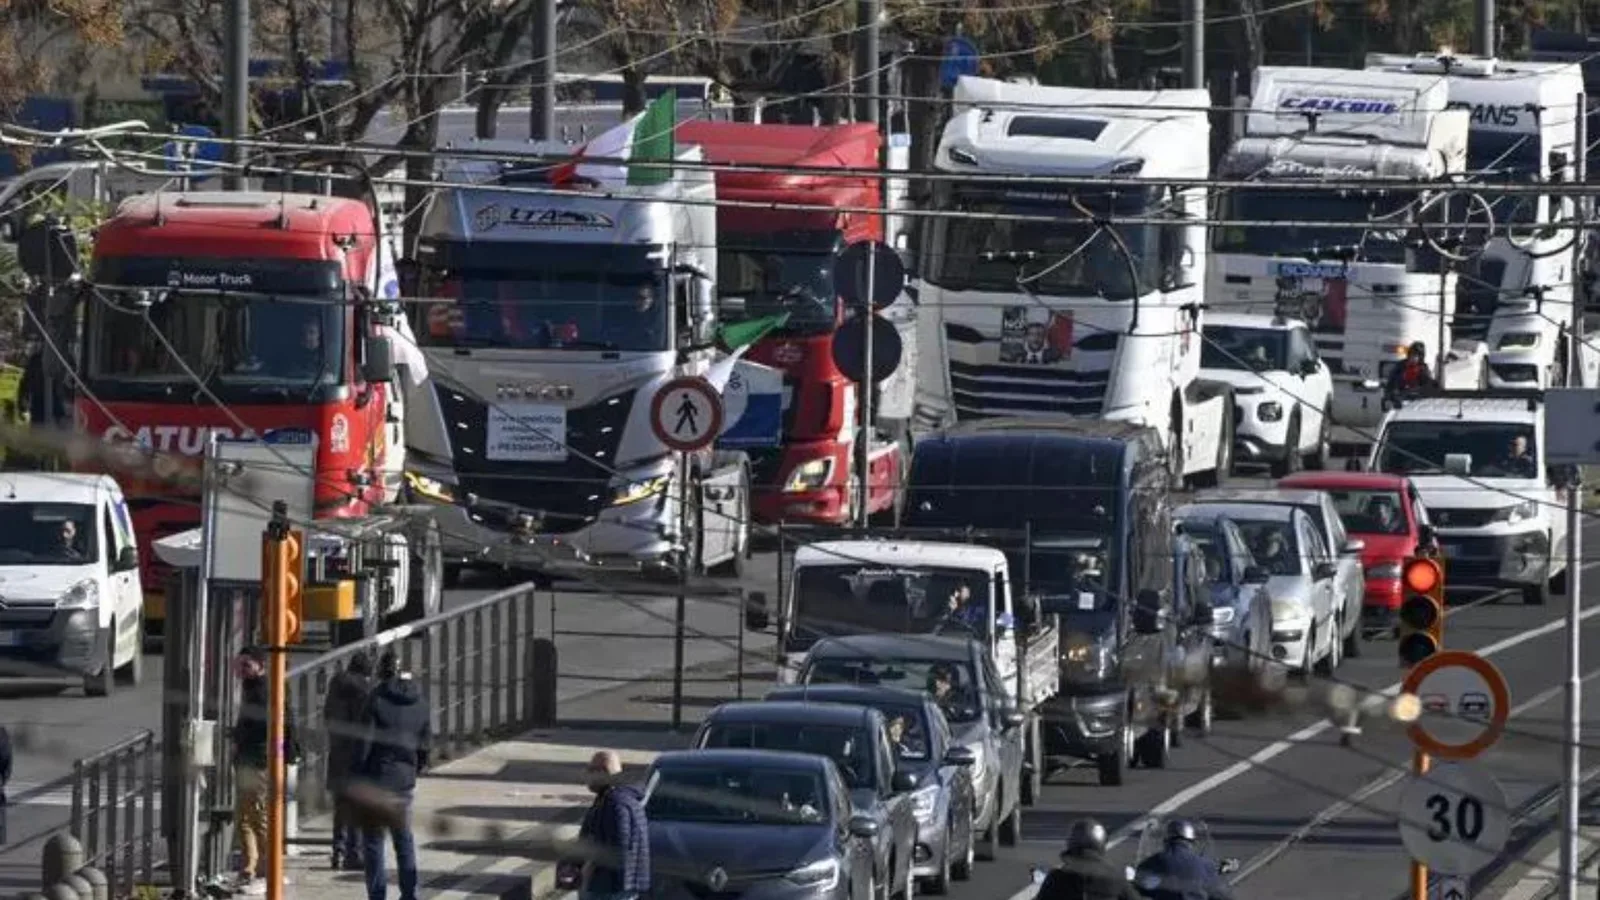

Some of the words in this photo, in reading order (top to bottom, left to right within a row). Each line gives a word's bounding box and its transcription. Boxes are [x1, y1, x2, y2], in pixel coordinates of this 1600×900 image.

[183, 272, 217, 285] Motor
[219, 271, 252, 285] Truck
[1425, 793, 1484, 842] 30
